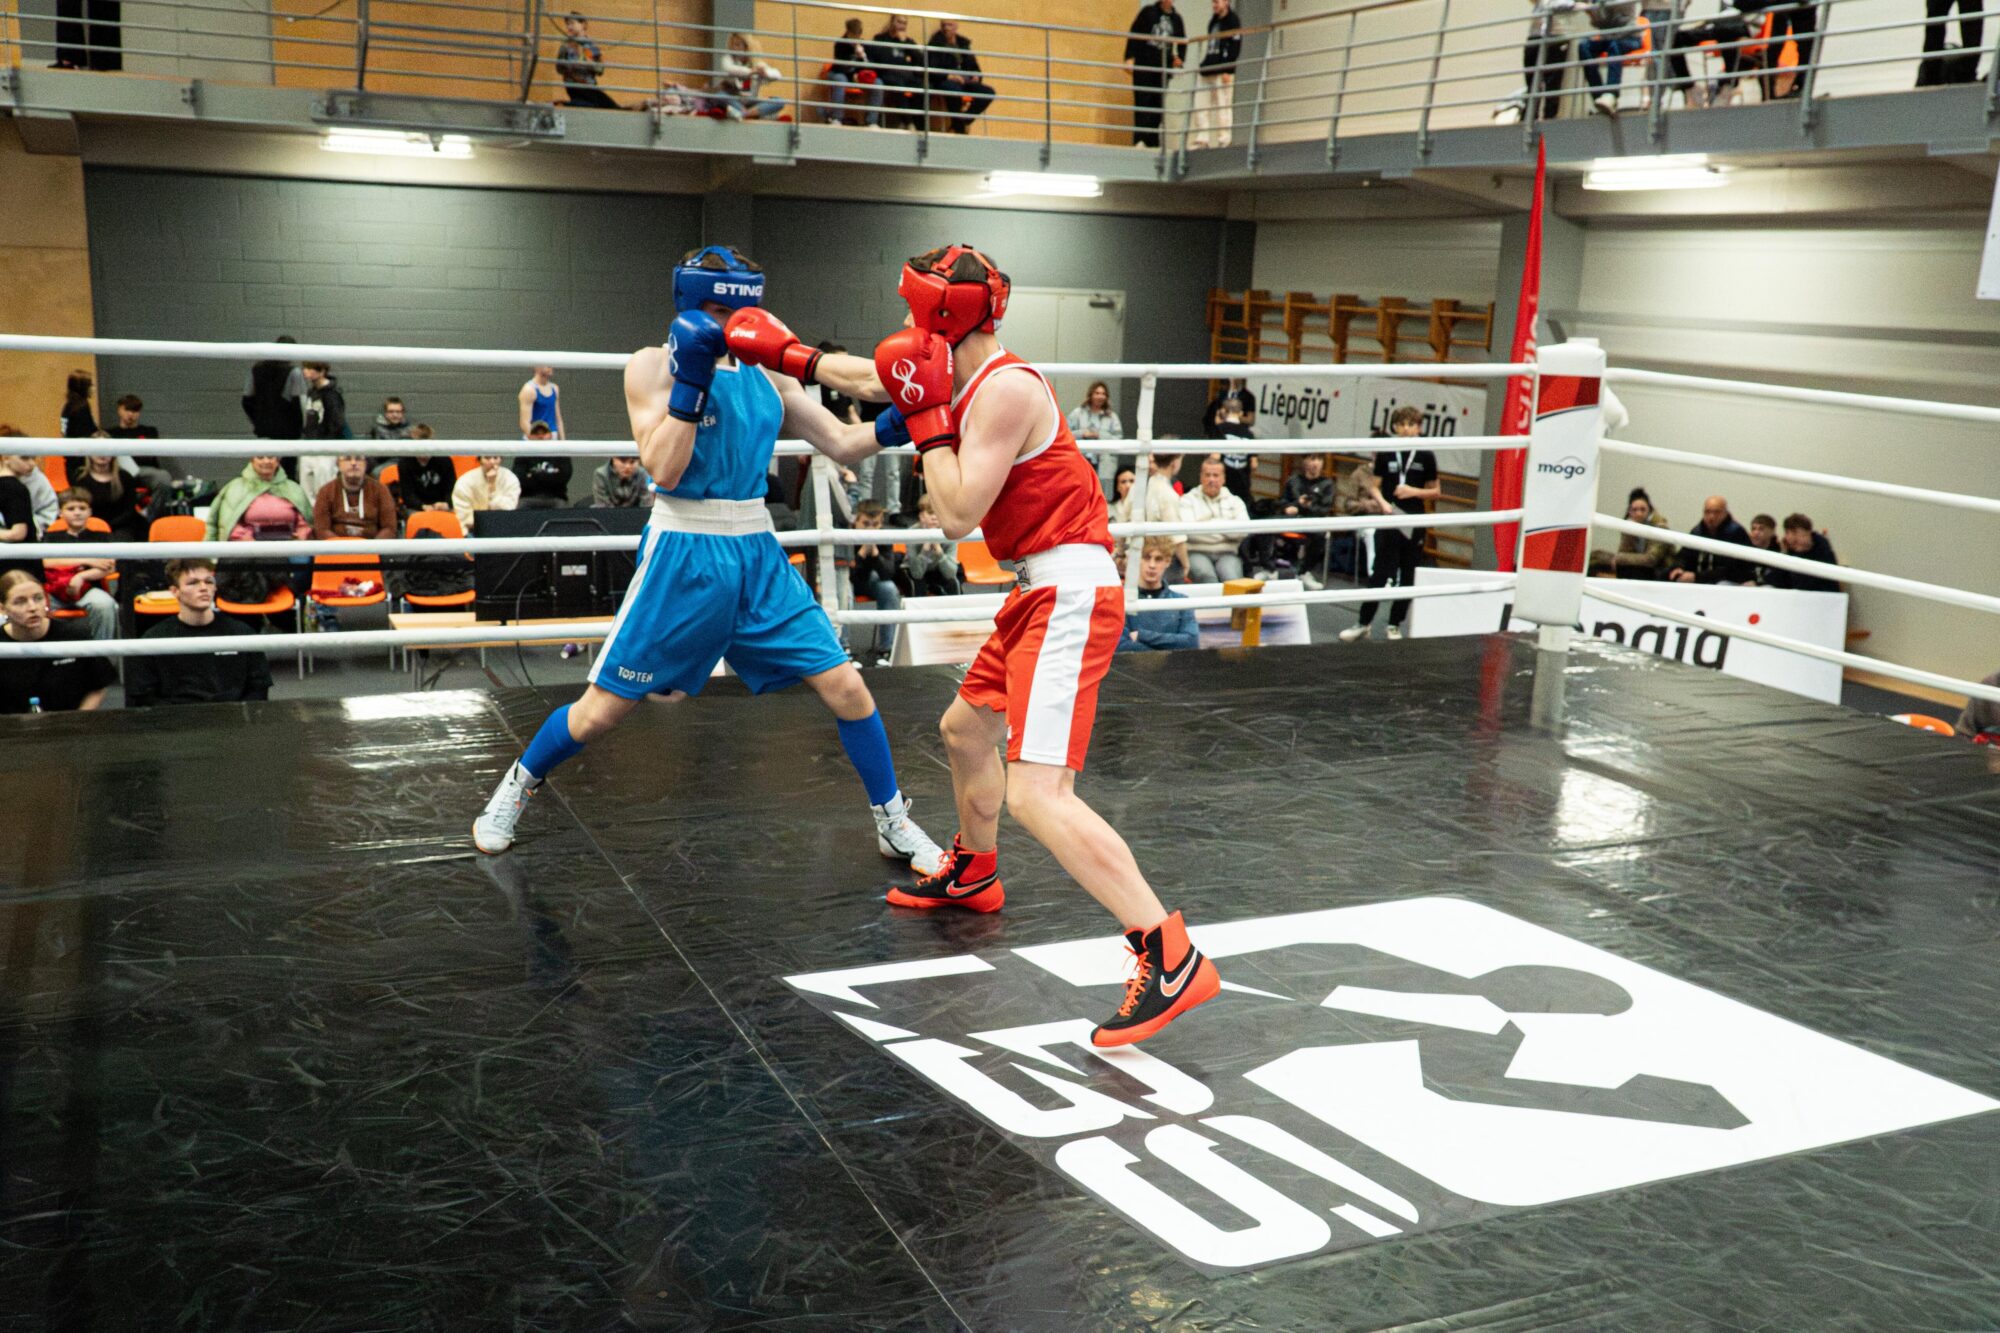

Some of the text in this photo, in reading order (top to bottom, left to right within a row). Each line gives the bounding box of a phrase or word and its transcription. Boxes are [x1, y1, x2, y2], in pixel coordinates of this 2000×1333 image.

[713, 282, 764, 297] STING
[1259, 384, 1330, 430] Liepāja
[1537, 463, 1586, 479] mogo
[618, 665, 654, 683] TOP TEN
